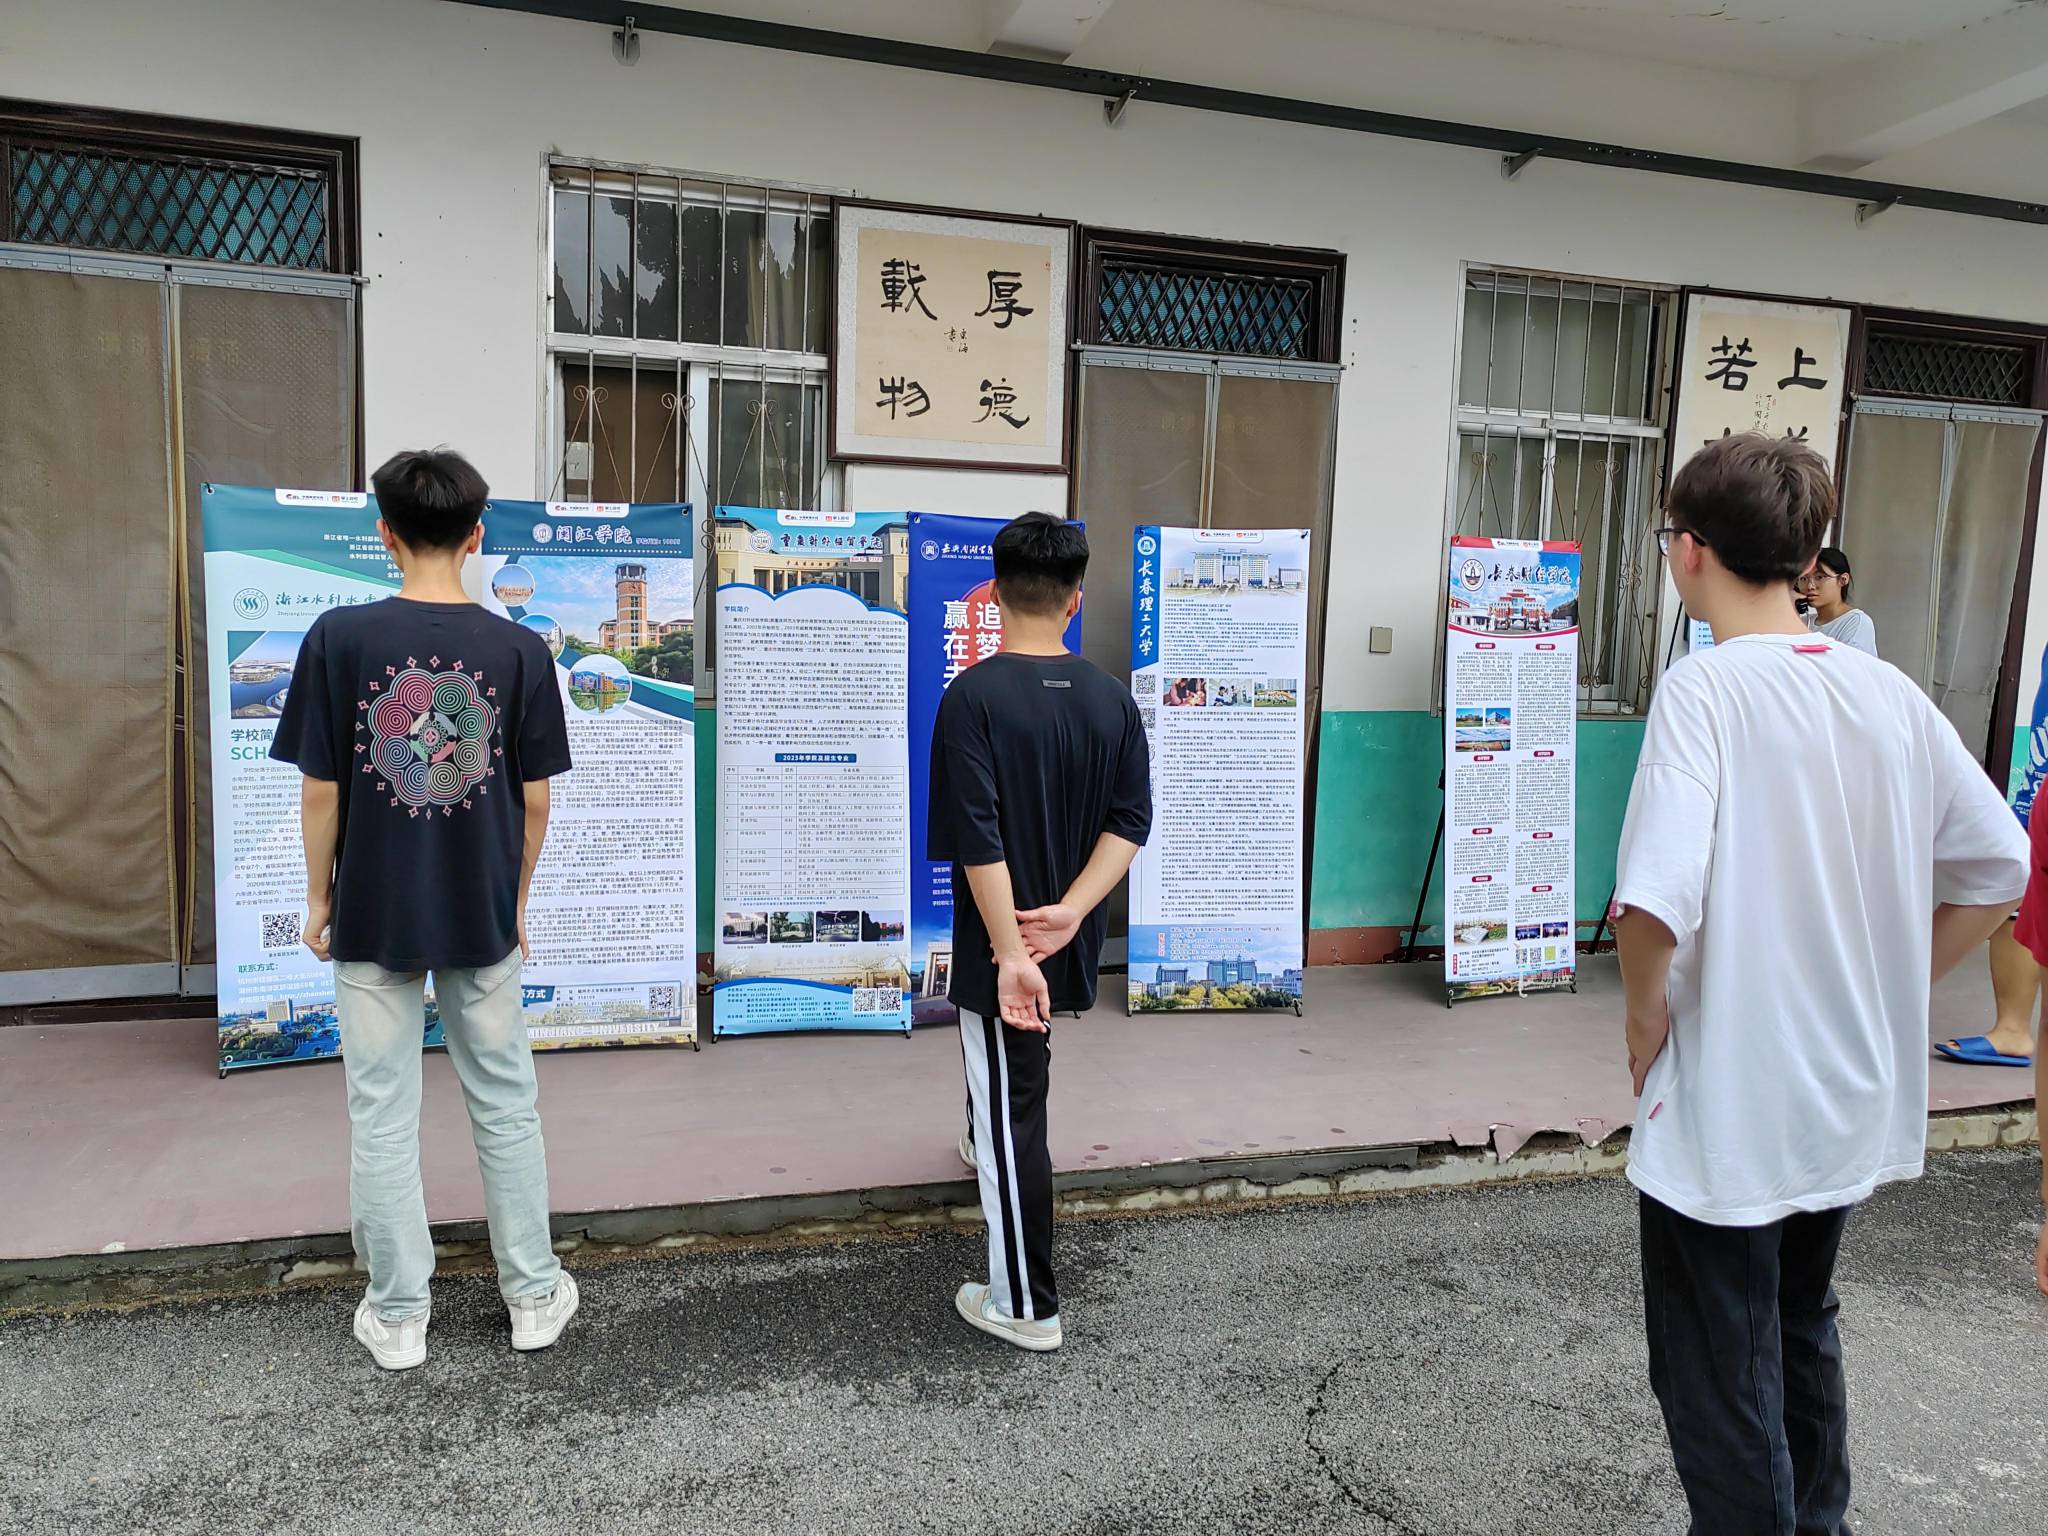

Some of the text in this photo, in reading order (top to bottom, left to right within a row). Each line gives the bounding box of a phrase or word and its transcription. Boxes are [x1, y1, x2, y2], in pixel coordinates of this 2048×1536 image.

[556, 524, 633, 544] 闽江学院
[276, 591, 395, 606] 浙江水利水
[976, 601, 1002, 660] 追梦
